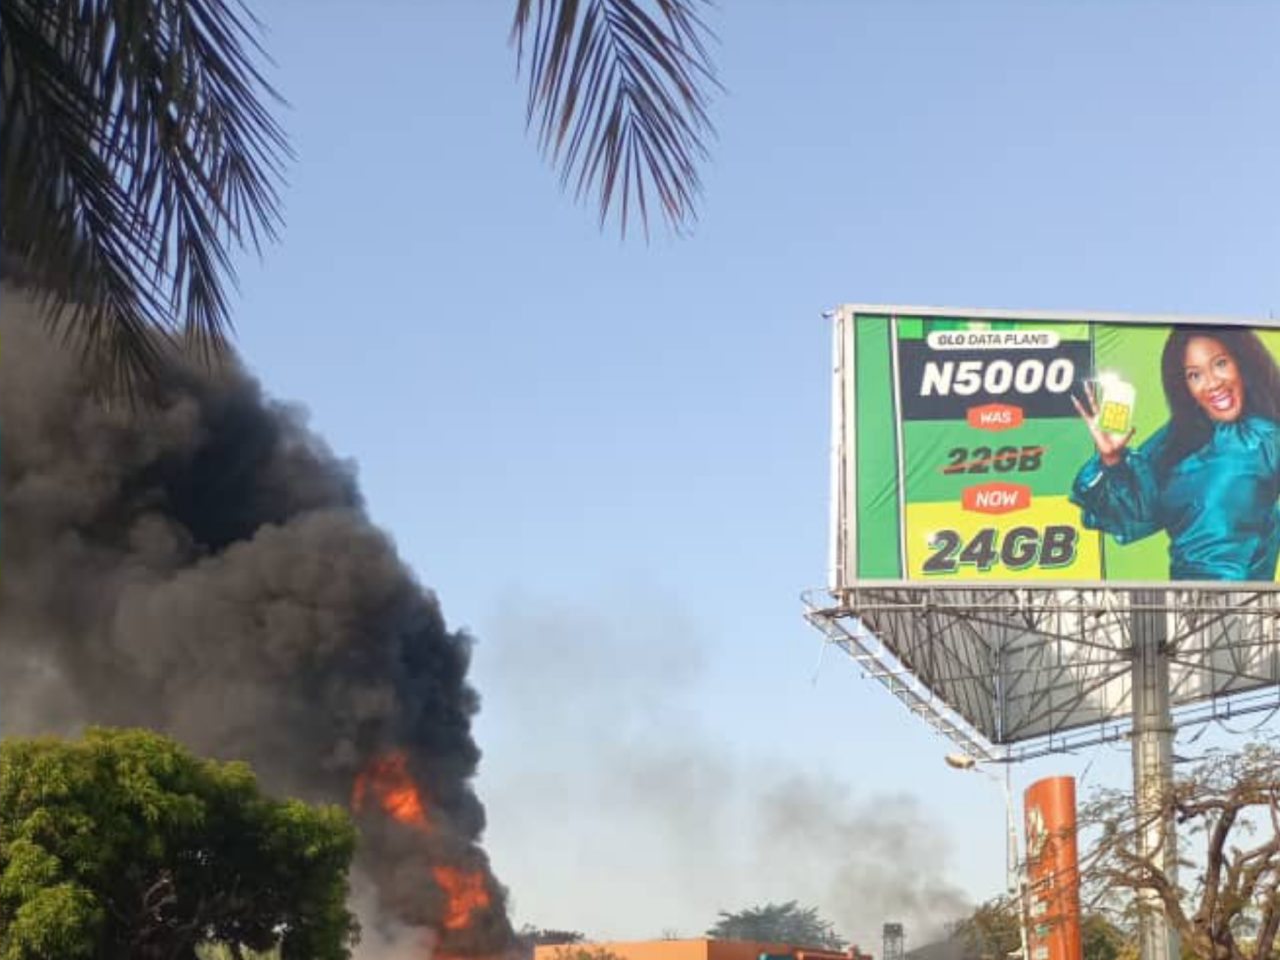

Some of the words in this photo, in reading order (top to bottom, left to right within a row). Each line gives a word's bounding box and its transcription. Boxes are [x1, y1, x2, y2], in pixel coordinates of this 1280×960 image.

[966, 333, 1000, 346] DATA
[1003, 334, 1049, 346] PLANS
[920, 358, 1075, 397] N5000
[979, 410, 1012, 425] WAS
[943, 445, 1043, 475] 22GB
[975, 490, 1017, 507] NOW
[921, 525, 1078, 573] 24GB
